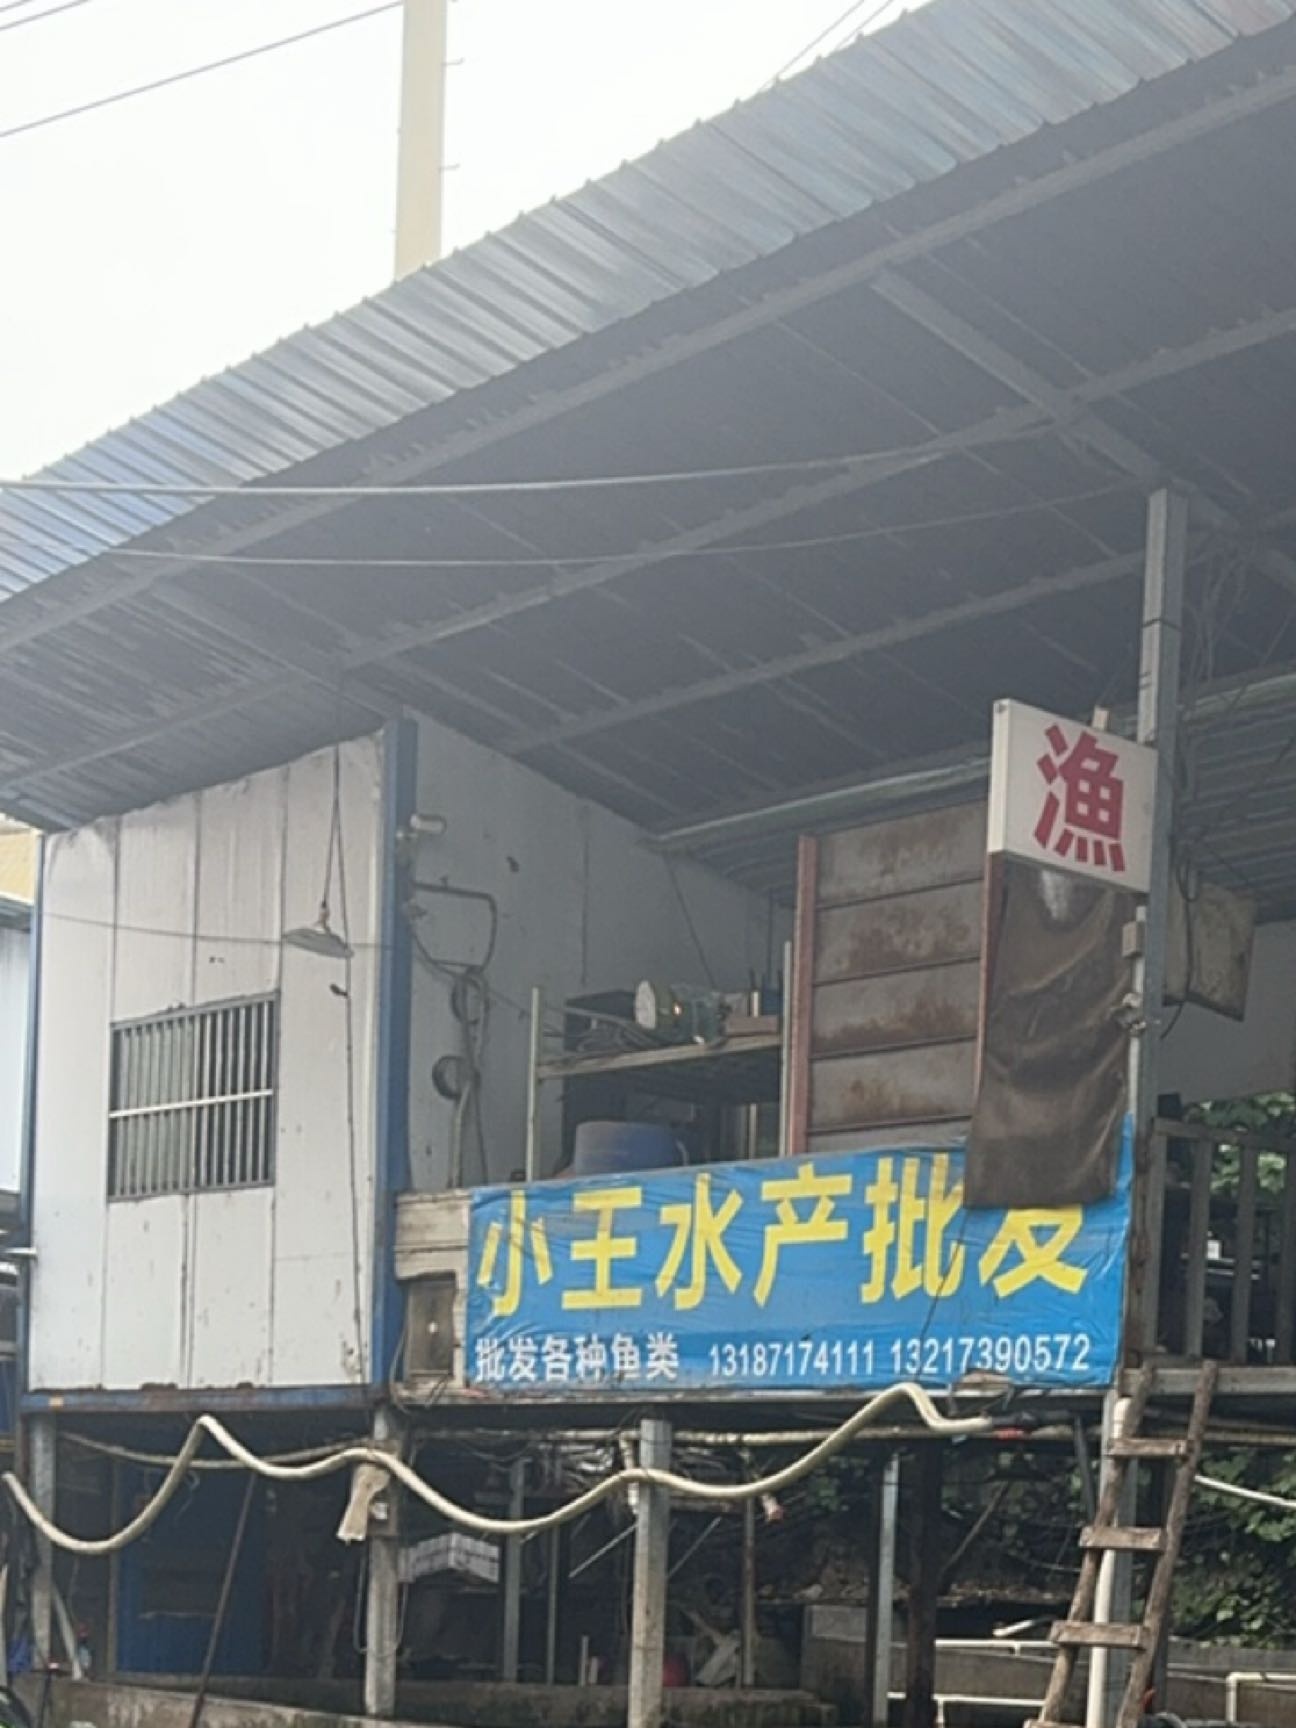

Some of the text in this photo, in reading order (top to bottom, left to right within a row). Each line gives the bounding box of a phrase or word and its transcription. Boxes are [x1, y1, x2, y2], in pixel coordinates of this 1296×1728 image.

[1034, 724, 1126, 872] 漁
[475, 1333, 1090, 1382] 批发各种鱼类 13187174111 13217390572
